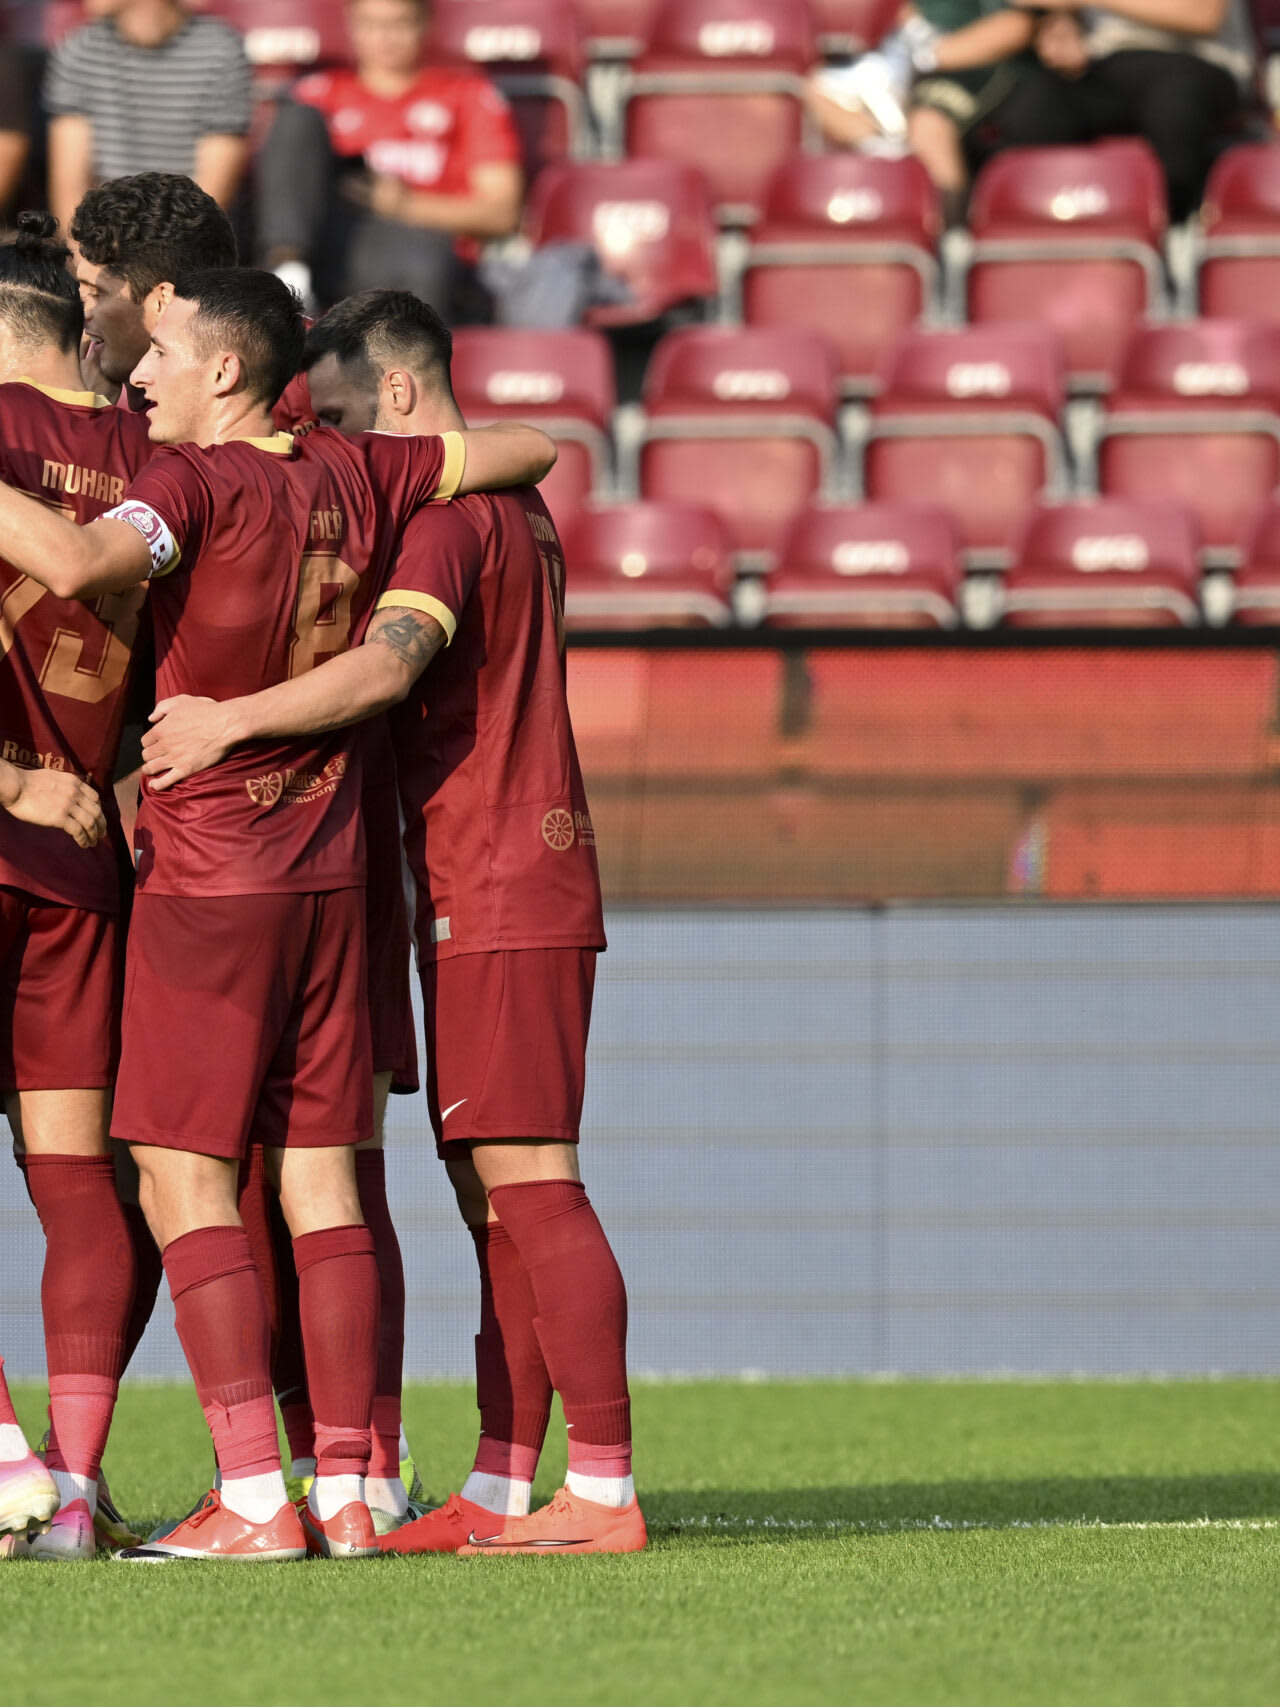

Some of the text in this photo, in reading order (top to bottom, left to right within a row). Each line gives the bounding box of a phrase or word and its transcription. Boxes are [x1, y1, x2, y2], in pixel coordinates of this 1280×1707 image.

[41, 459, 124, 504] MUHAR
[309, 504, 343, 540] FICĂ
[2, 739, 66, 772] Roata
